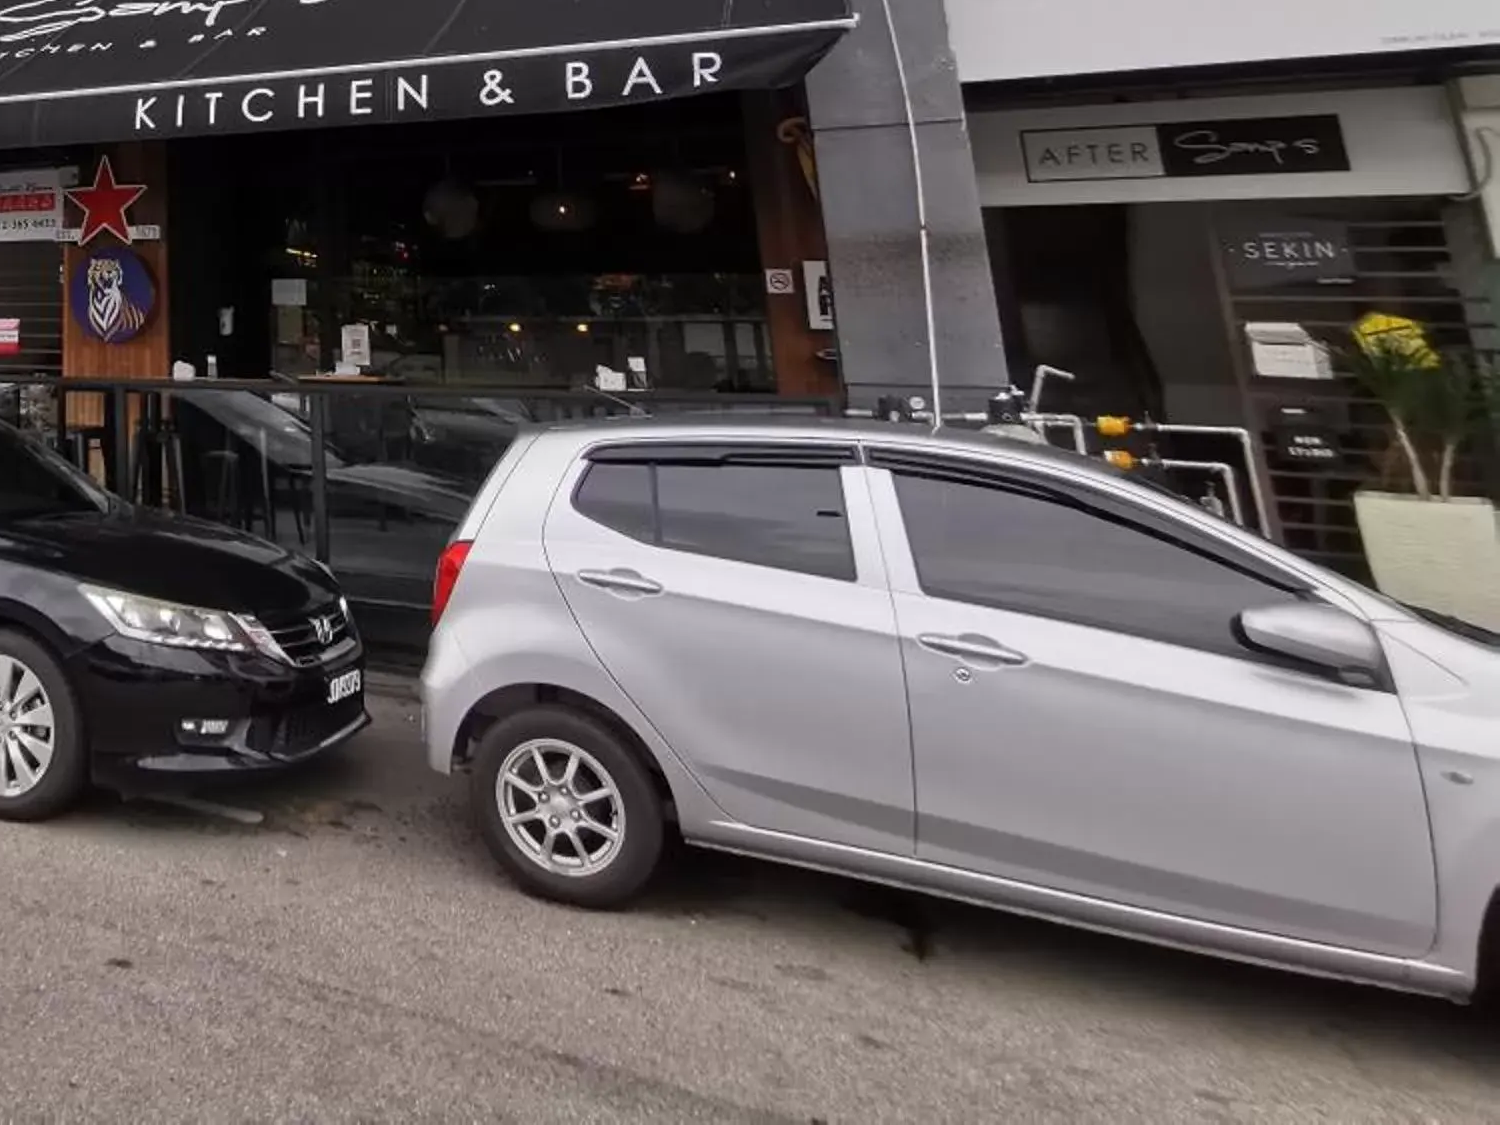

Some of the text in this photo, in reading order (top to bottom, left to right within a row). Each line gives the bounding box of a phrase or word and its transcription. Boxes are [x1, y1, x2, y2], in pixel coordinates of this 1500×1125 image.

[134, 52, 722, 131] KITCHEN & BAR
[1038, 142, 1150, 167] AFTER
[1242, 241, 1336, 259] SEKIN
